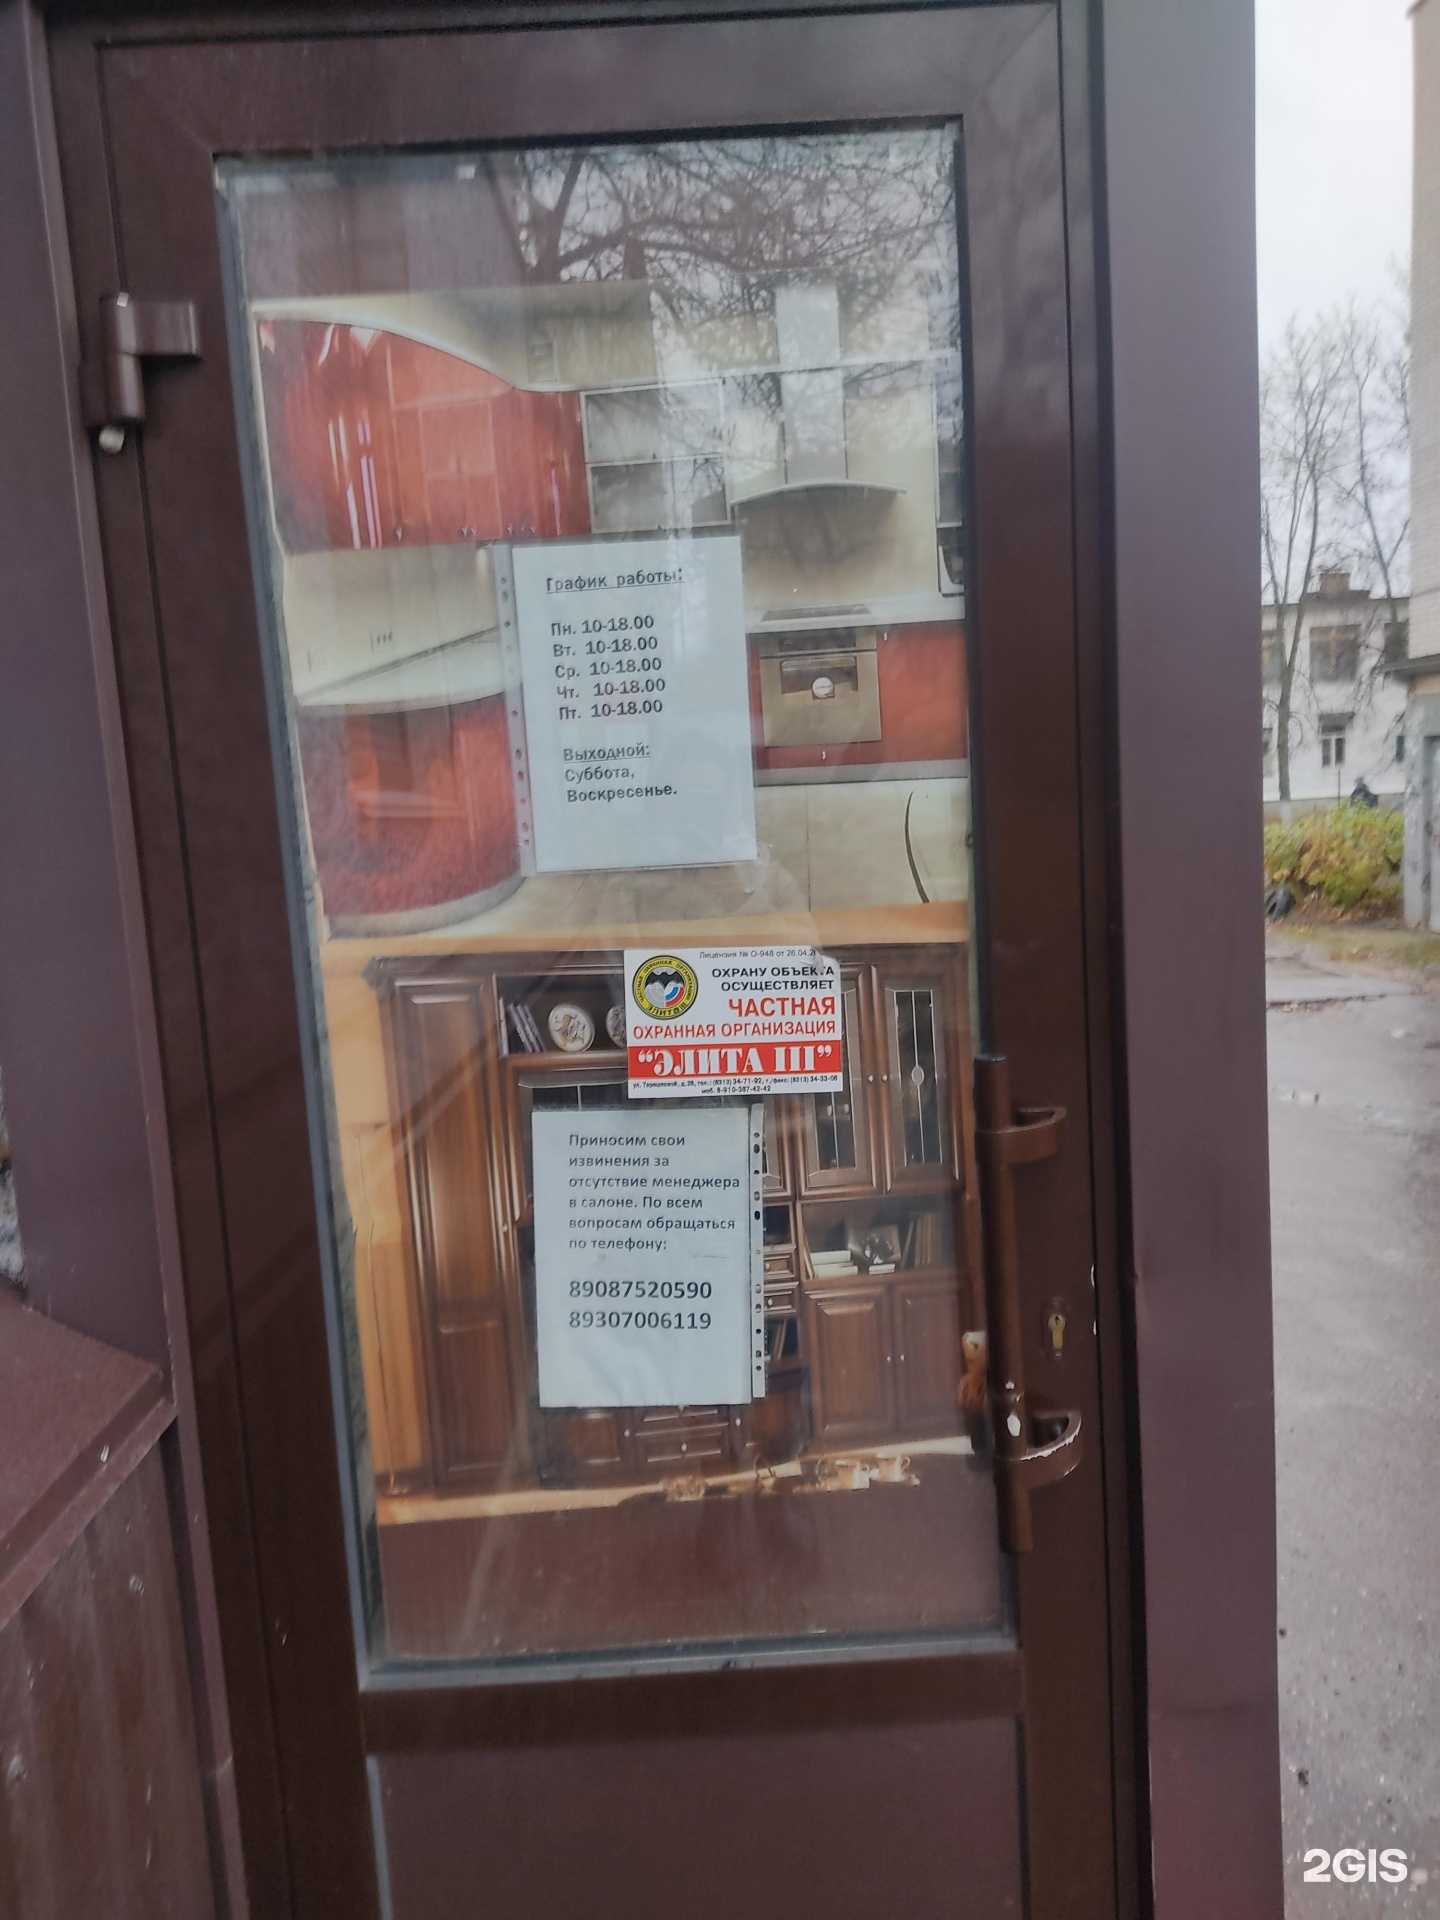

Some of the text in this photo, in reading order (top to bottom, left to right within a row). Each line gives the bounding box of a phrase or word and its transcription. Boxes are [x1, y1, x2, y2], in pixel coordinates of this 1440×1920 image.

[546, 568, 684, 593] График работы:
[551, 615, 655, 637] Пн. 10-18.00
[553, 636, 658, 658] Вт. 10-18.00
[555, 657, 662, 681] Ср. 10-18.00
[556, 678, 666, 700] Чт. 10-18.00
[559, 699, 663, 720] Пт. 10-18.00
[563, 743, 651, 762] Выходной:
[565, 765, 635, 783] Суббота,
[567, 783, 678, 803] Воскресенье.
[712, 967, 768, 978] ОХРАНУ
[721, 980, 834, 992] ОСУЩЕСТВЛЯЕТ
[729, 997, 836, 1017] ЧАСТНАЯ
[633, 1021, 836, 1040] ОХРАННАЯ ОРГАНИЗАЦИЯ
[569, 1134, 685, 1149] Приносим свои
[569, 1155, 670, 1167] извинения за
[569, 1176, 740, 1190] отсутствие менеджера
[569, 1196, 703, 1209] в салоне. По всем
[569, 1215, 735, 1232] вопросам обращаться
[569, 1236, 667, 1252] по телефону:
[569, 1280, 712, 1300] 89087520590
[569, 1311, 712, 1330] 89307006119
